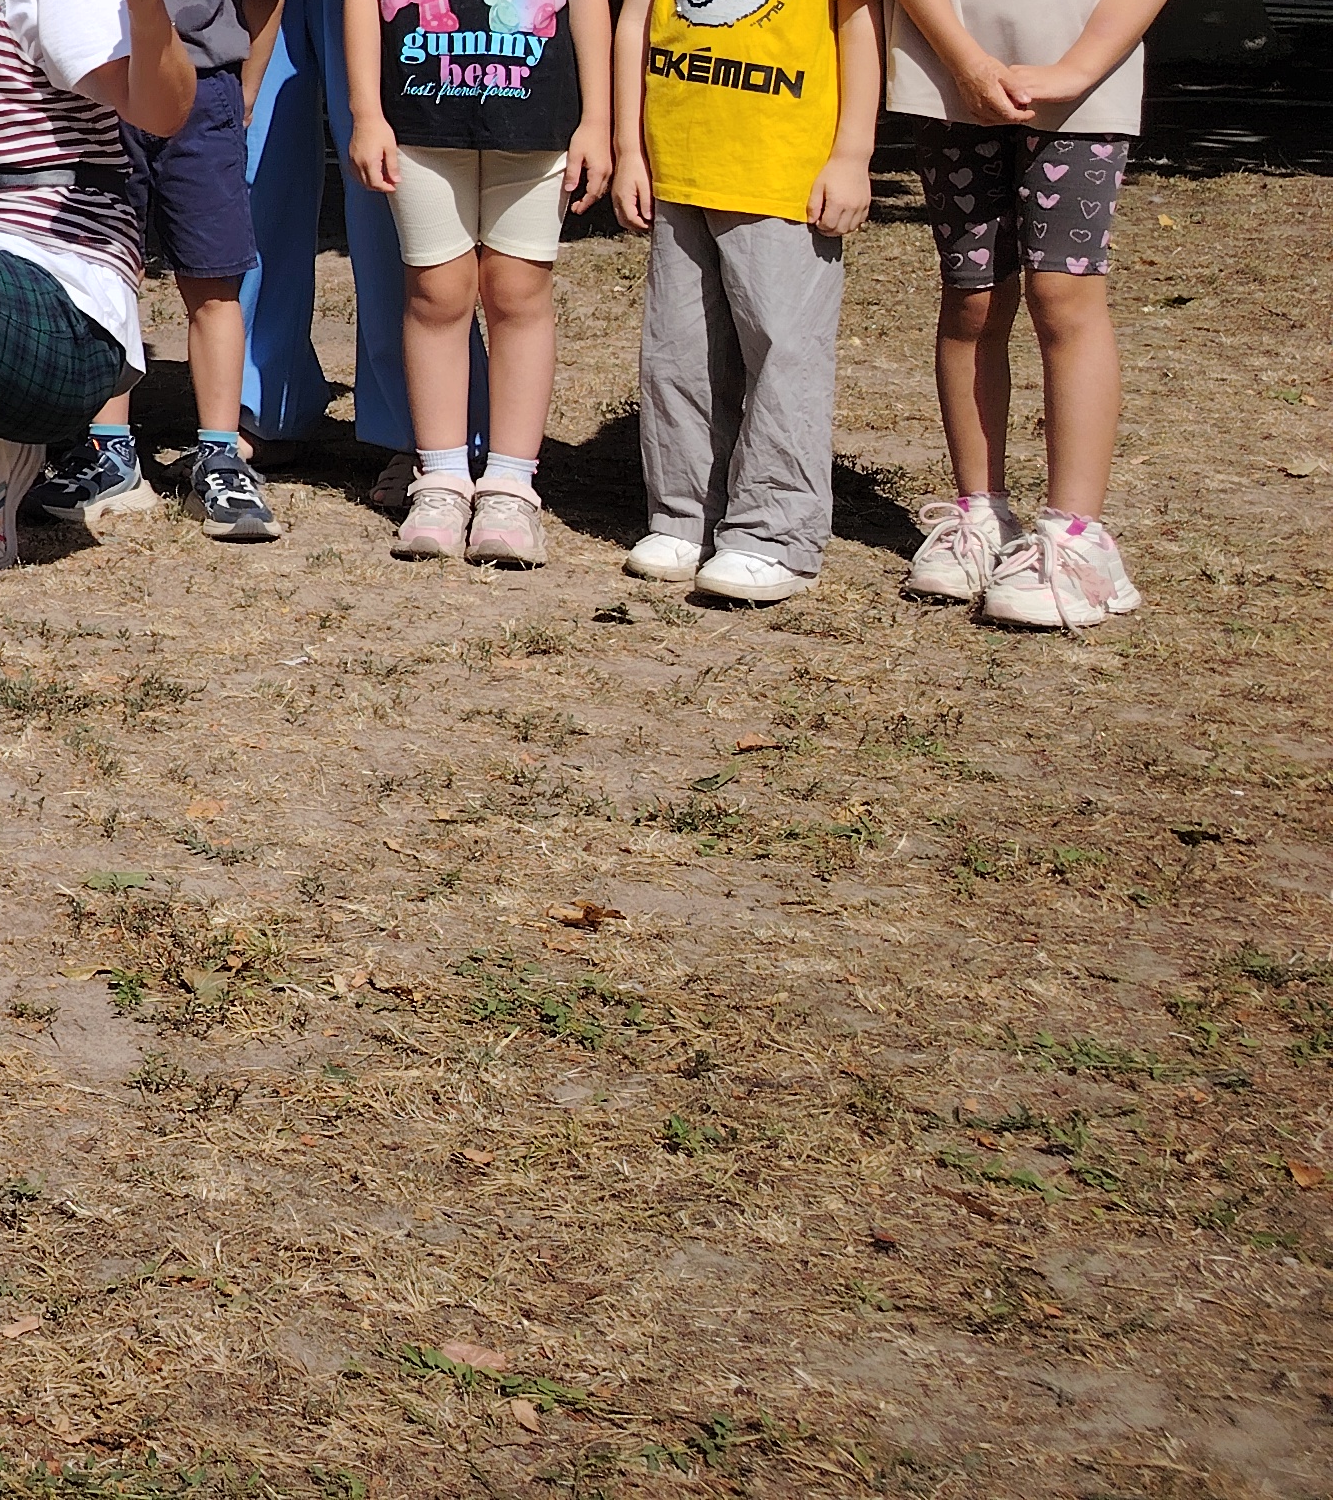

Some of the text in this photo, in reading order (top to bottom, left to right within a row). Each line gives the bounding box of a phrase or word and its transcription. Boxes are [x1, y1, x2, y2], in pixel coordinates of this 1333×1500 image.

[400, 27, 549, 67] gummy
[439, 54, 530, 89] bear
[480, 74, 531, 105] forever
[649, 47, 805, 99] OKÉMON
